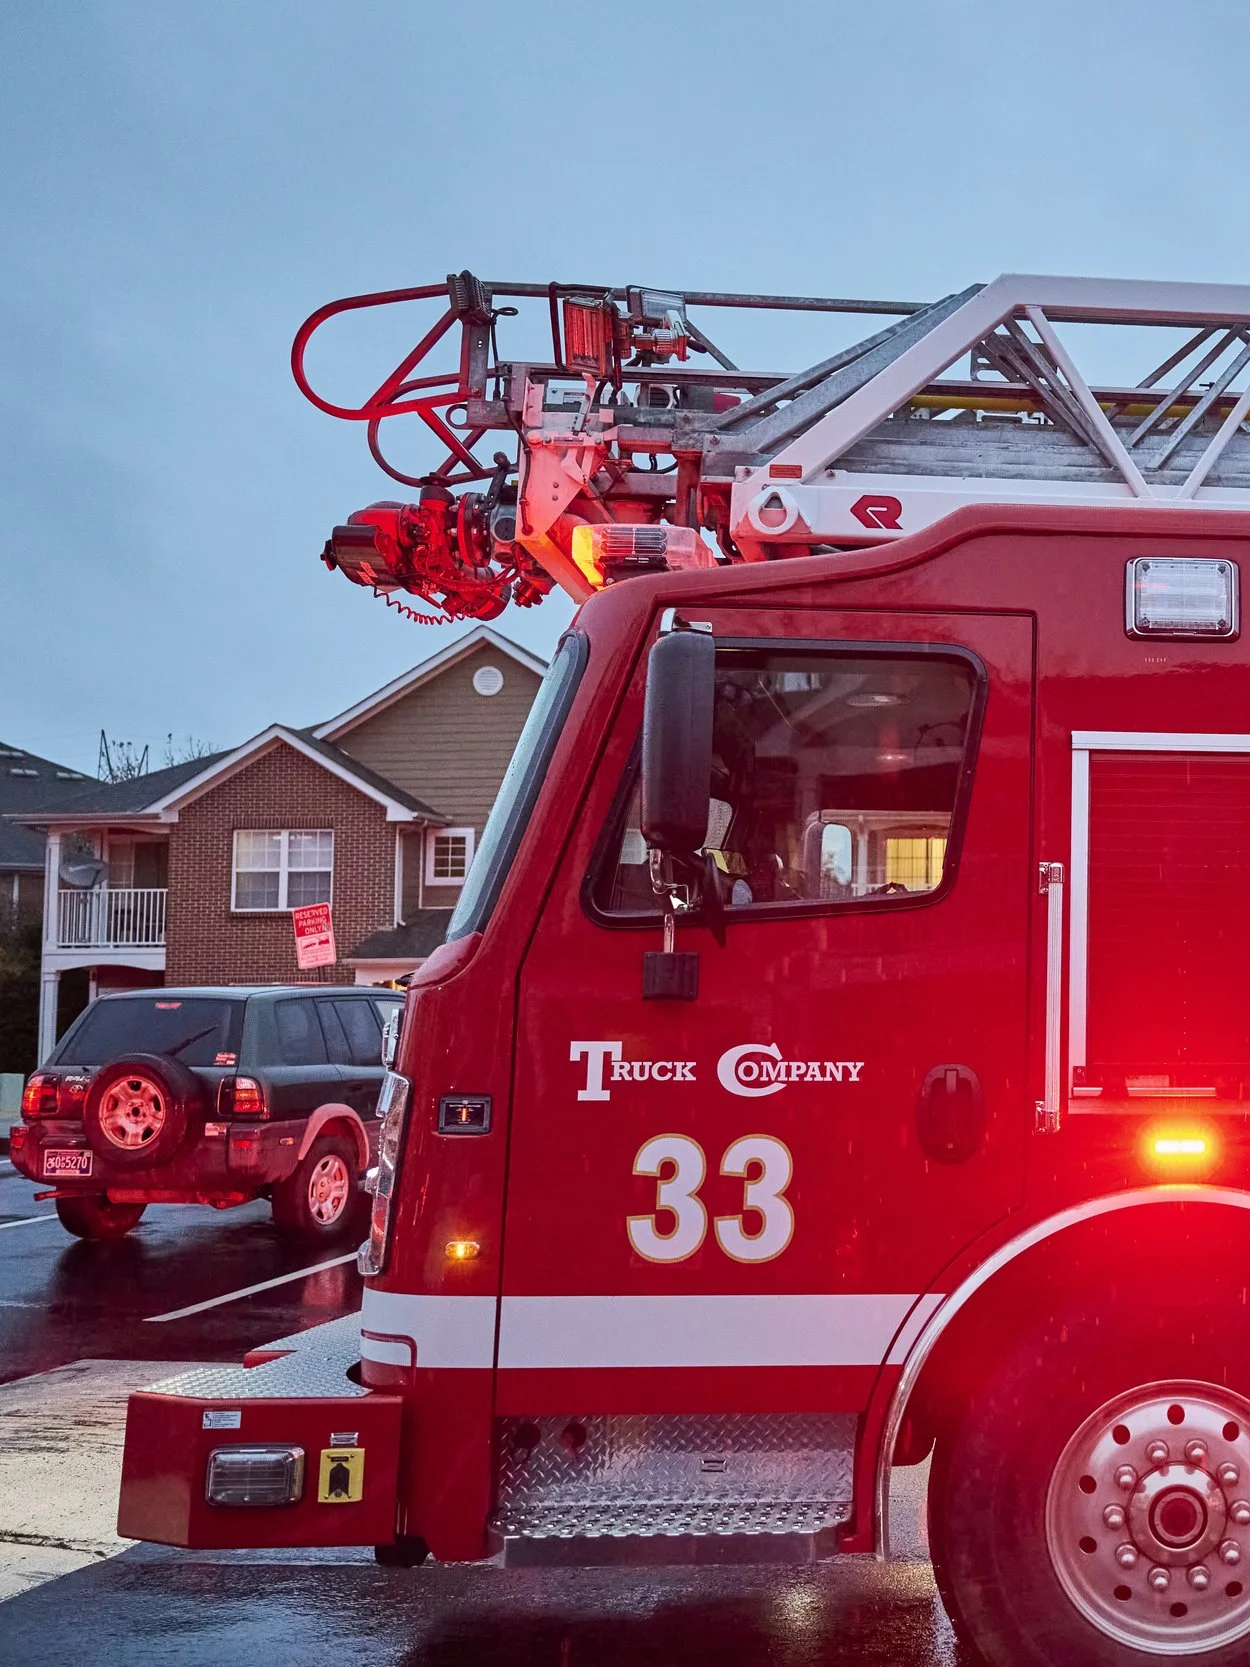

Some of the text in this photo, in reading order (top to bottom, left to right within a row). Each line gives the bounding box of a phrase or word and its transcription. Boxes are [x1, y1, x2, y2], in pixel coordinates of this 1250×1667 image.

[295, 907, 328, 920] RESERVED
[299, 916, 327, 928] PARKING
[569, 1041, 864, 1101] TRUCK COMPANY
[626, 1133, 795, 1264] 33
